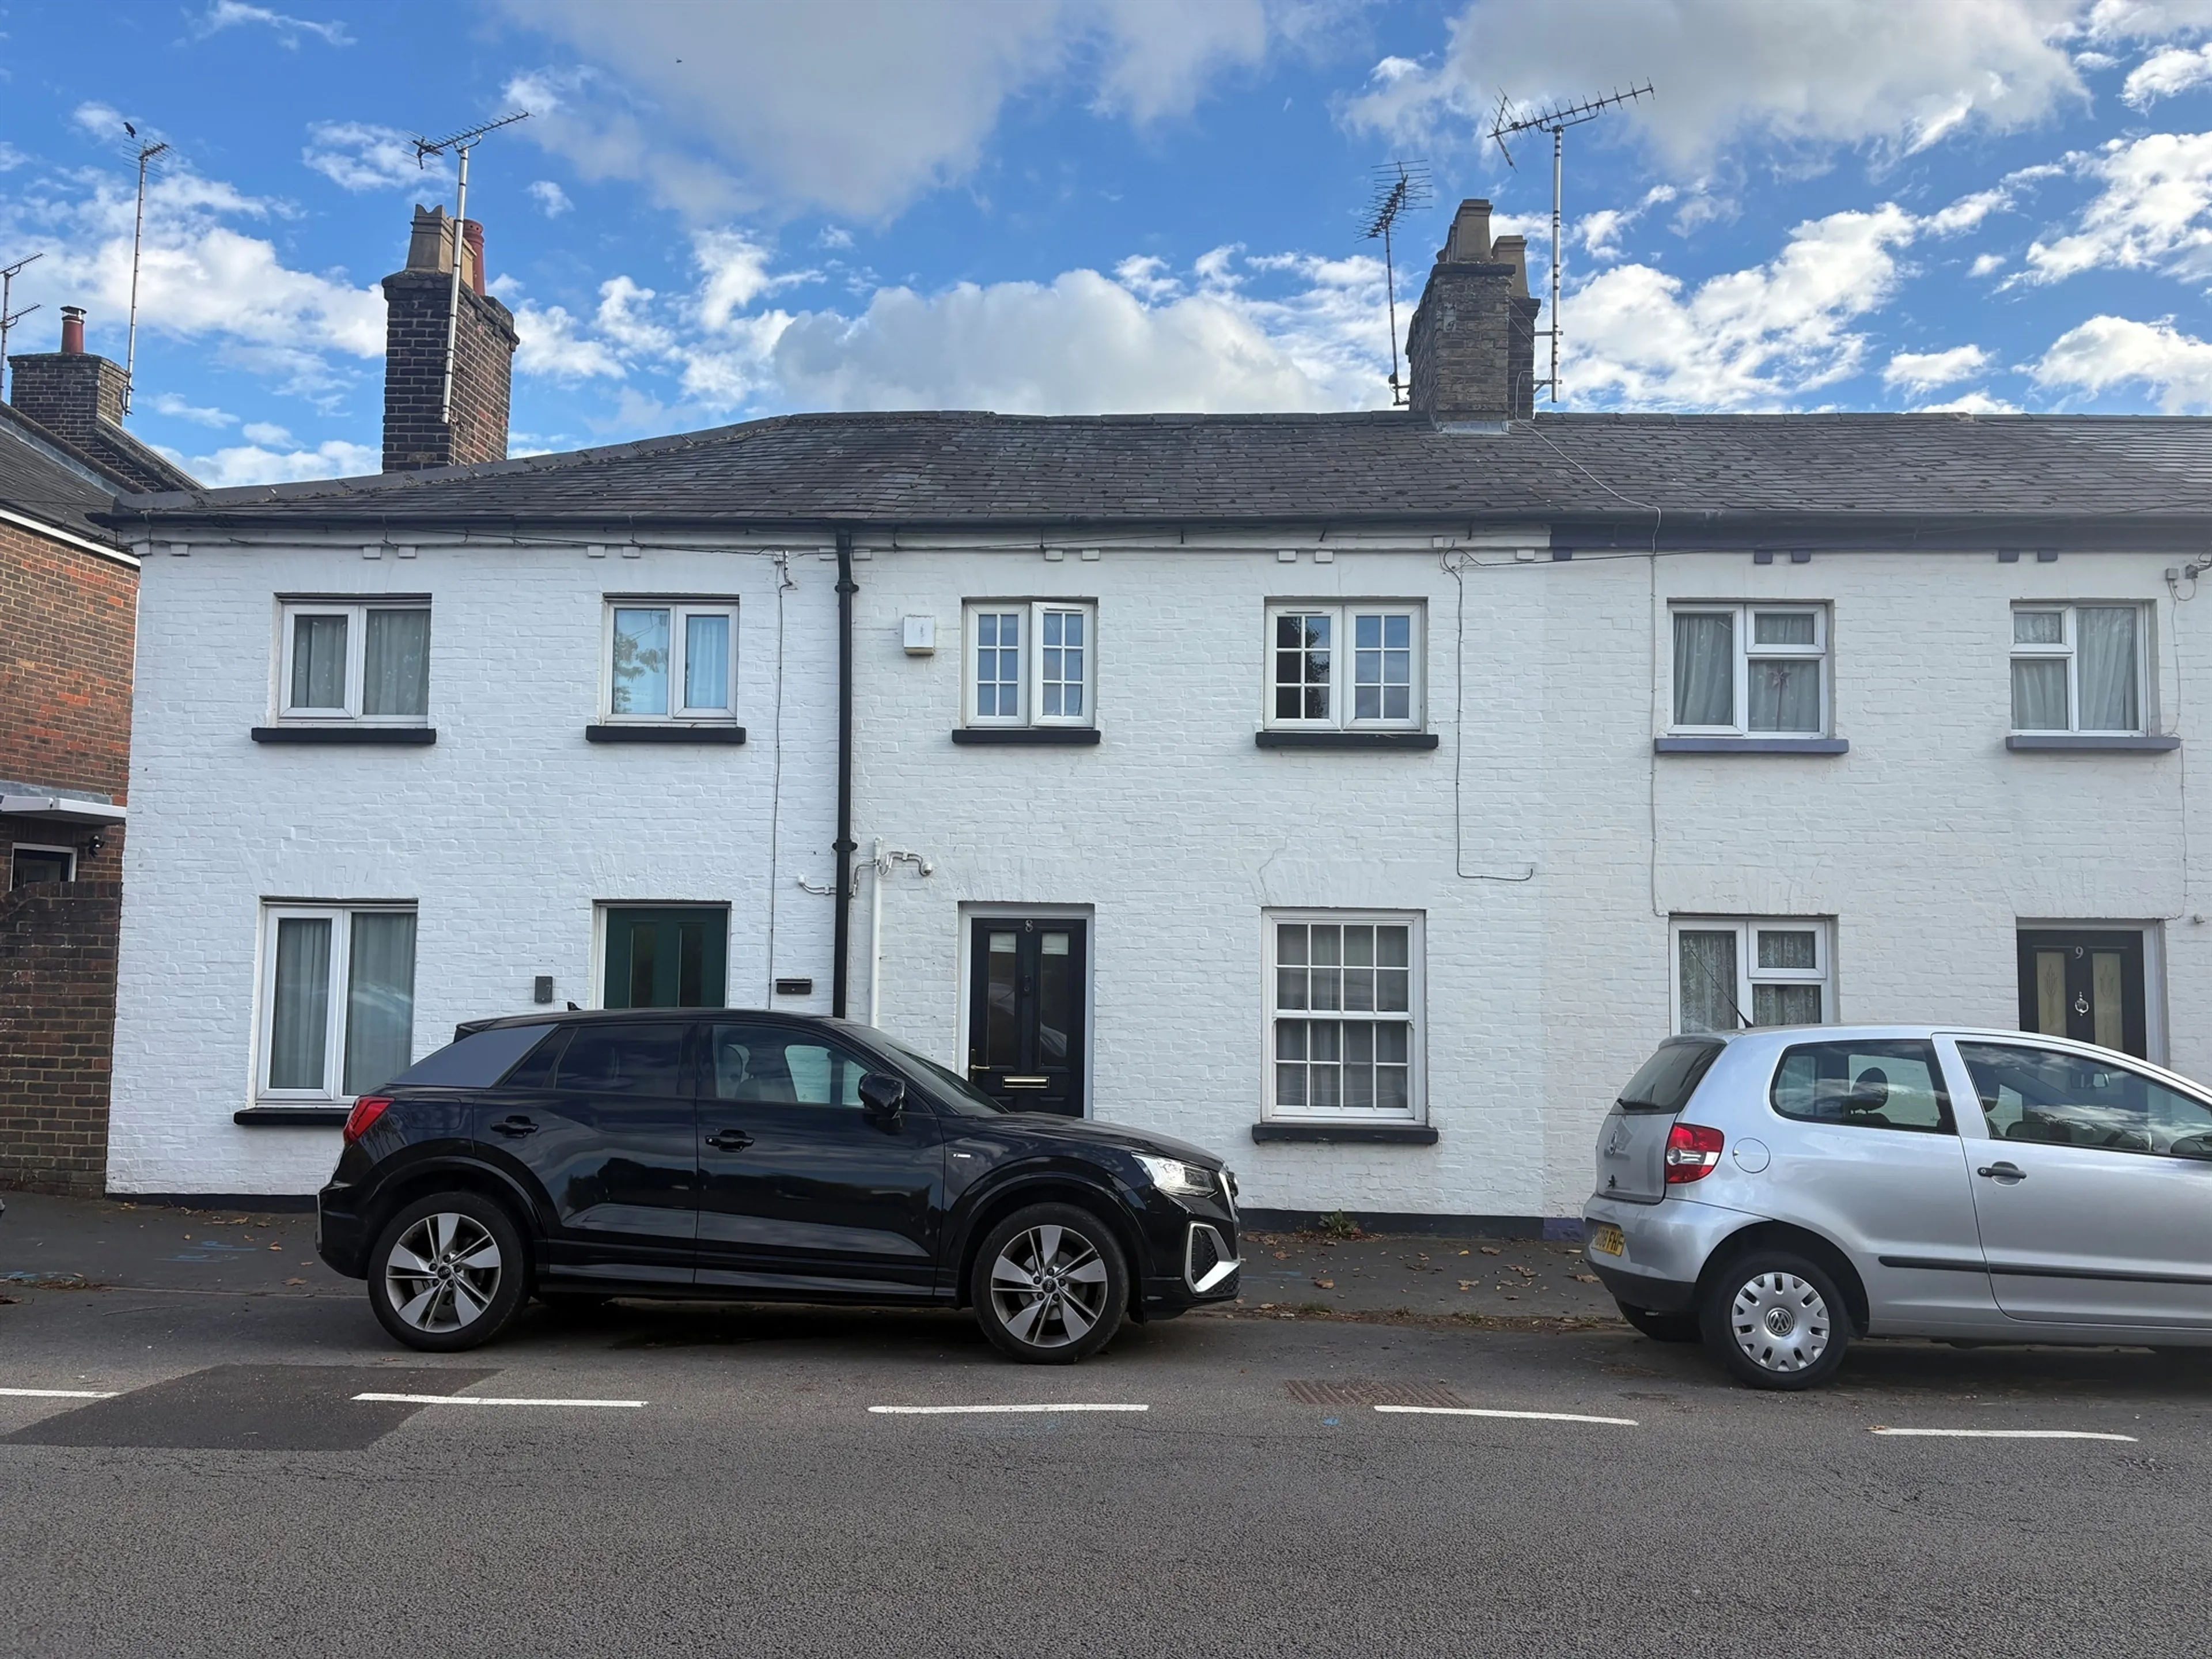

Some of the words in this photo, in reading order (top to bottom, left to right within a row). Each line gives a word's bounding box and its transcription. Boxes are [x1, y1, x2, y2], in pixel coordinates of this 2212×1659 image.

[1025, 920, 1033, 933] 8
[2075, 946, 2084, 959] 9
[546, 984, 551, 994] 7
